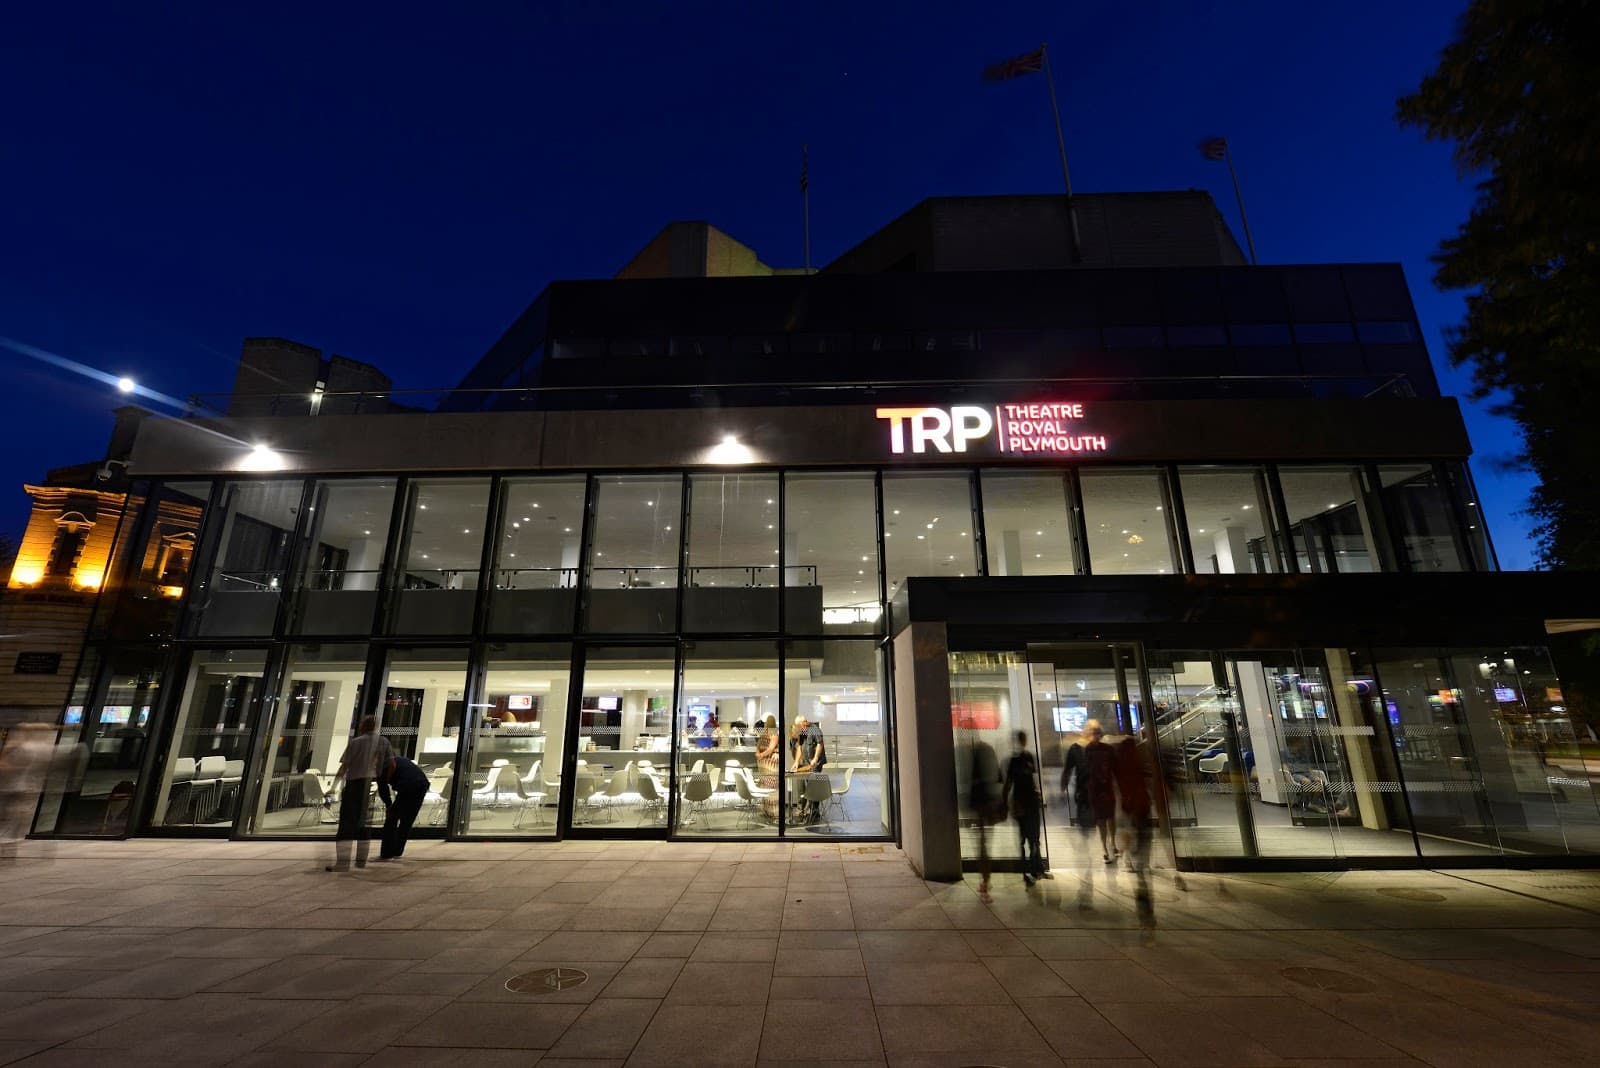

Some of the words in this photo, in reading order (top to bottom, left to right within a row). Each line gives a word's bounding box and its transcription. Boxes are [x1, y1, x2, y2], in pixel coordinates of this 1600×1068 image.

[1005, 404, 1083, 419] THEATRE
[876, 406, 993, 453] TRP
[1008, 420, 1067, 435] ROYAL
[1010, 436, 1106, 452] PLYMOUTH
